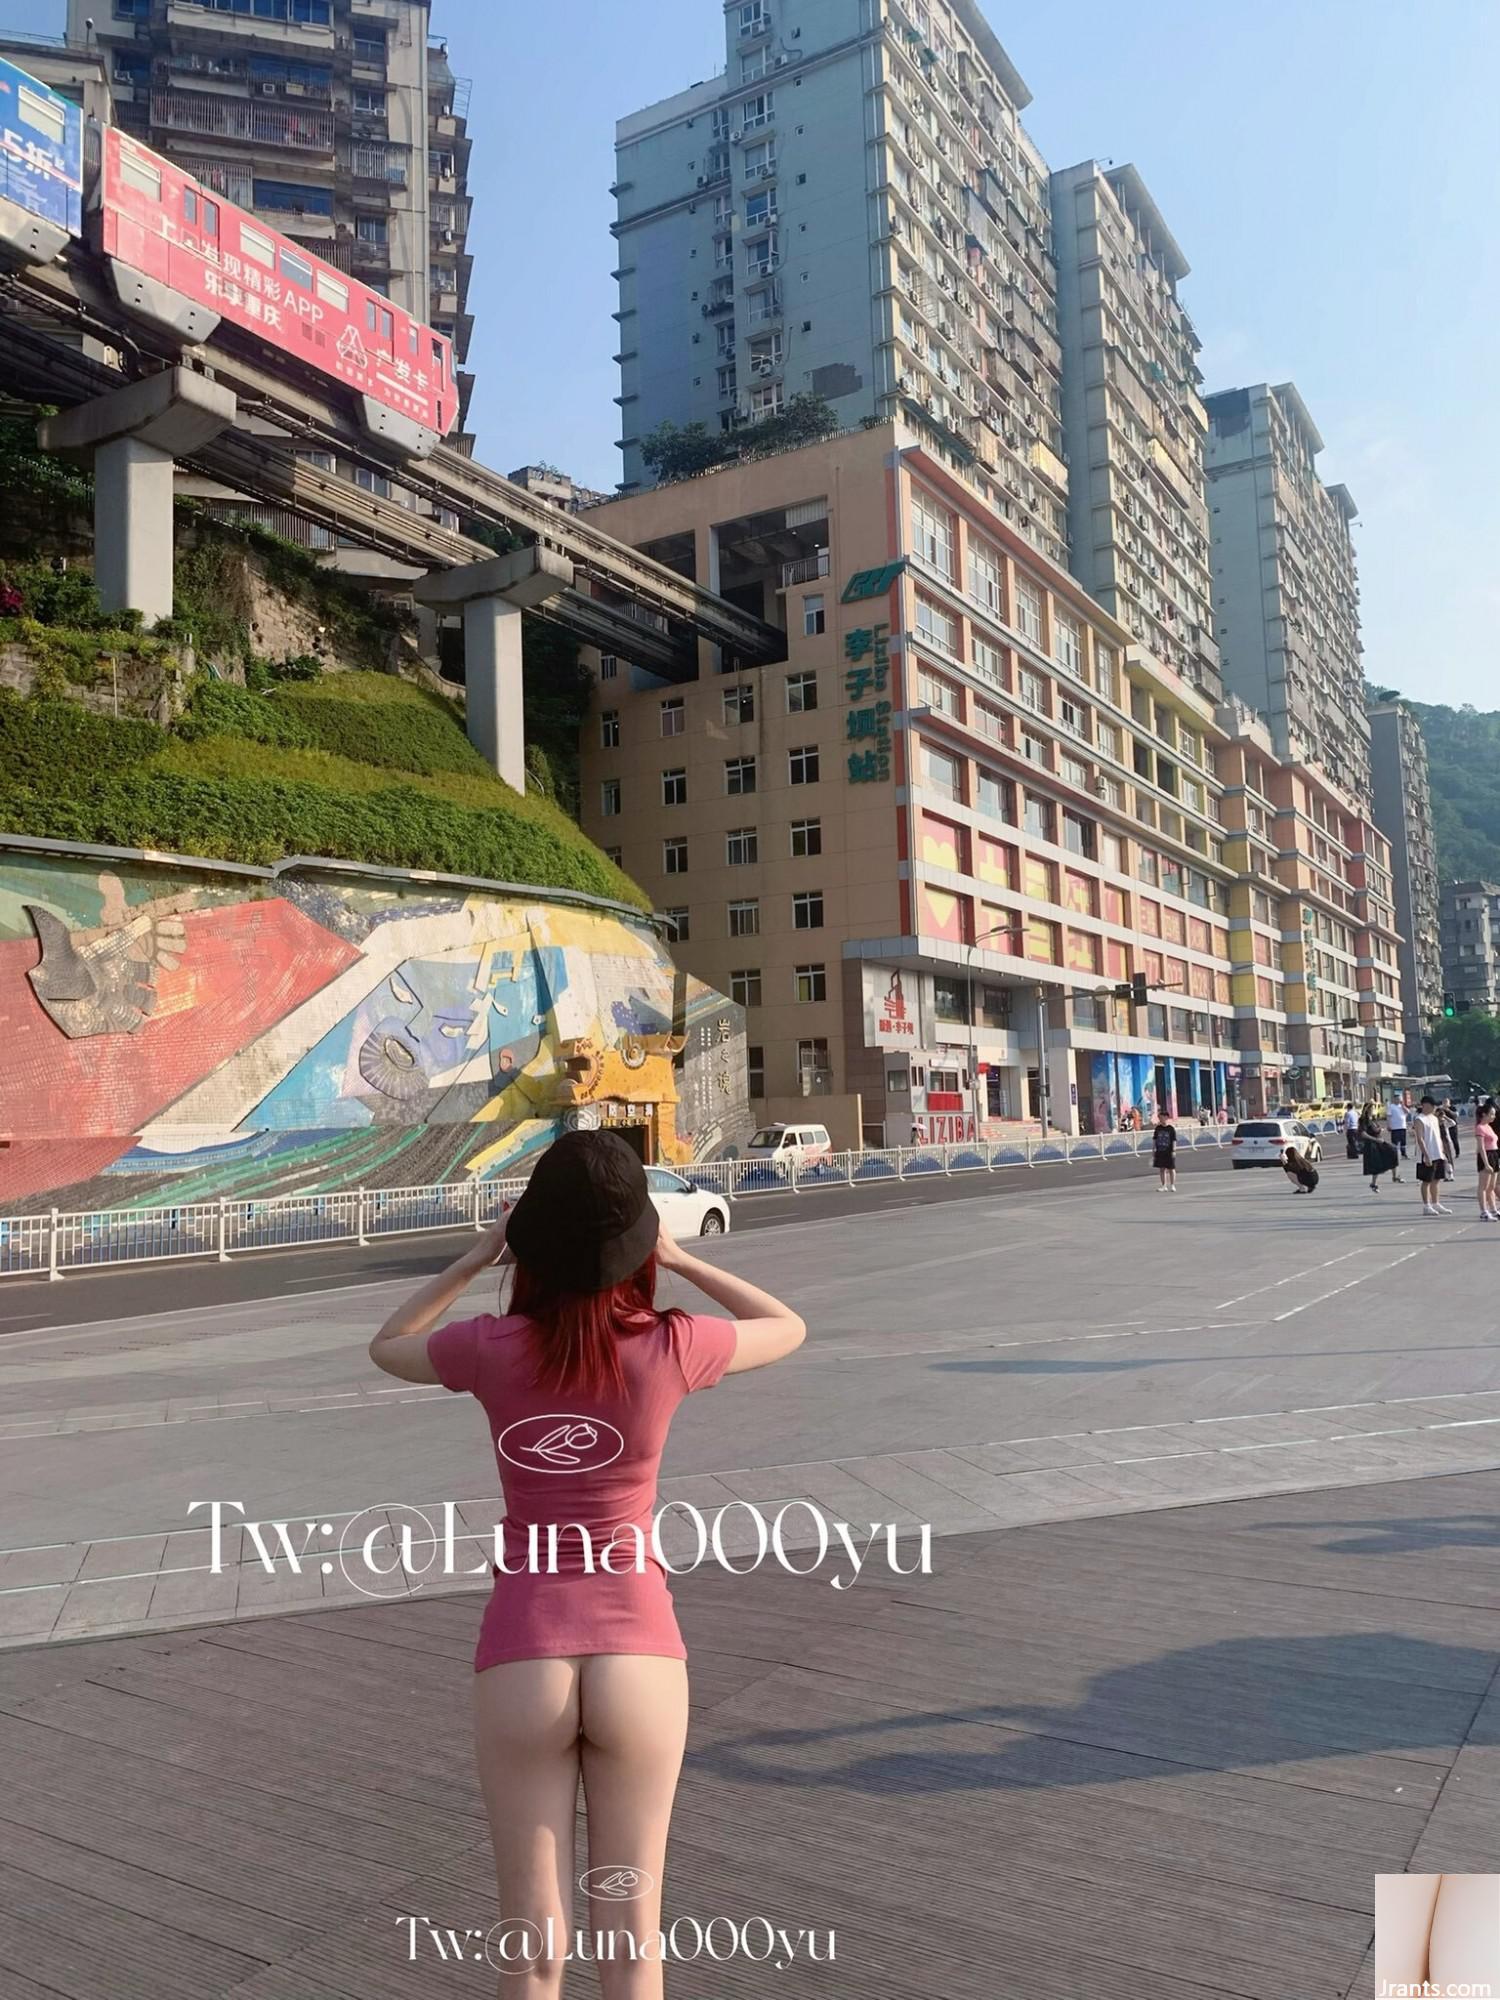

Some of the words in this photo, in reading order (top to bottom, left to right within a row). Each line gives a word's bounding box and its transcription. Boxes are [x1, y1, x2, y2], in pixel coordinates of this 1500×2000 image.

[204, 268, 283, 333] 乐享重庆
[376, 347, 429, 391] 广发卡
[845, 627, 878, 784] 李子坝站
[917, 1115, 976, 1147] LIZIBA
